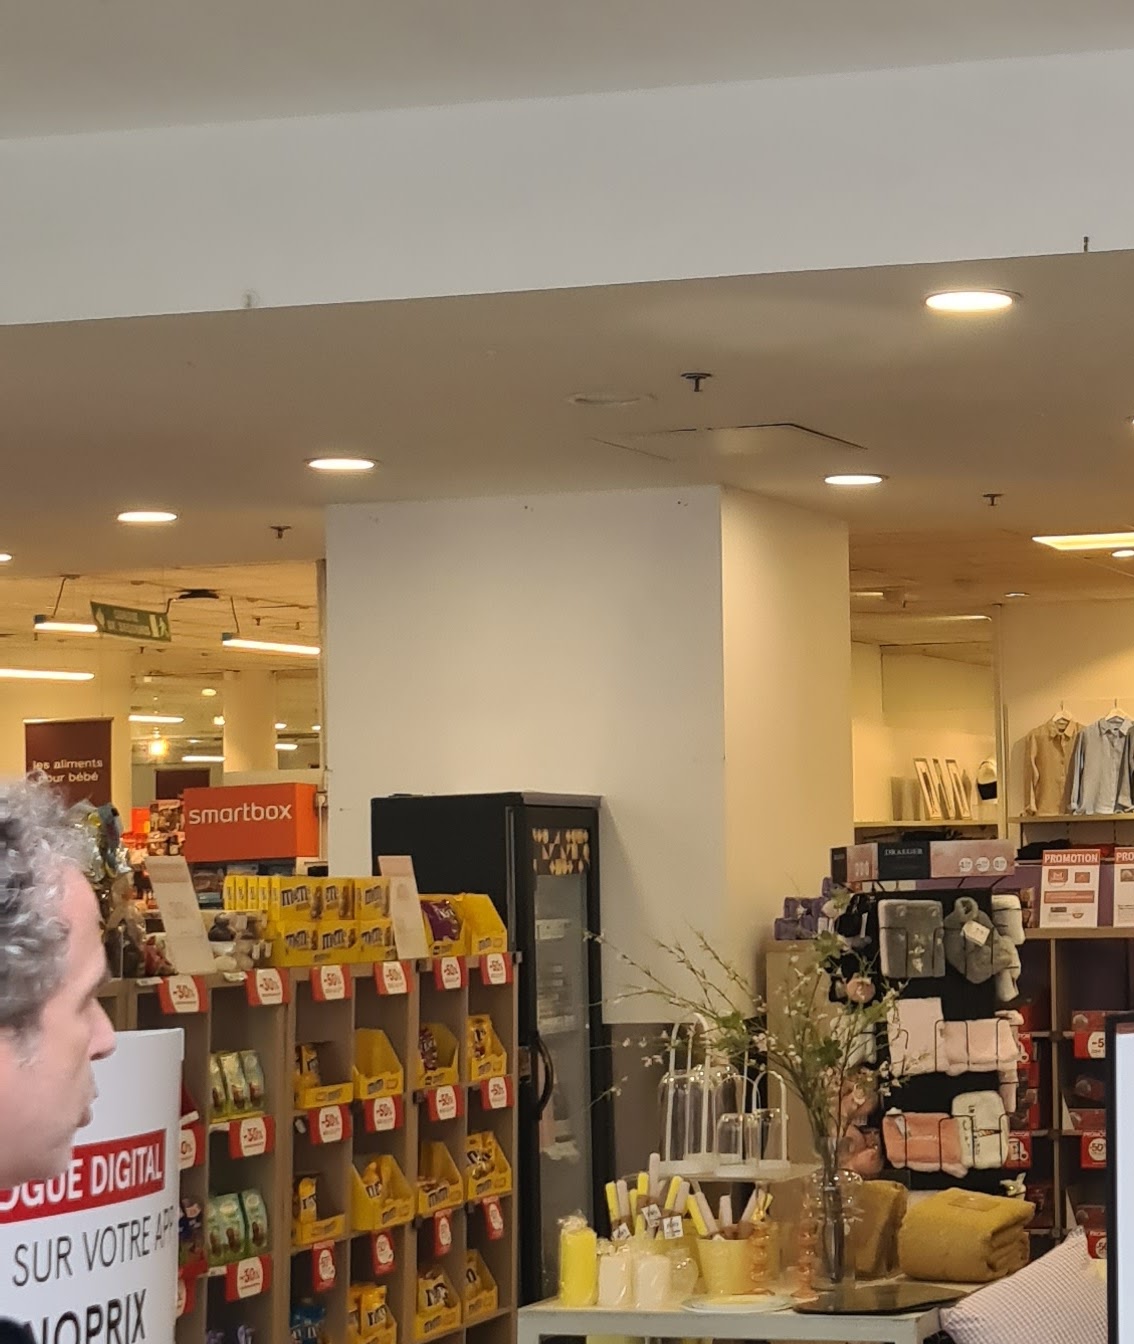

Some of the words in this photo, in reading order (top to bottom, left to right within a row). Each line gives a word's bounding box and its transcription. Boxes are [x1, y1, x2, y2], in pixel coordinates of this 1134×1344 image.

[32, 760, 51, 770] les
[54, 759, 103, 769] aliments
[68, 772, 99, 783] bébé
[188, 803, 292, 825] smartbox
[1044, 853, 1099, 864] PROMOTION
[90, 1143, 163, 1196] DIGITAL
[12, 1235, 73, 1287] SUR
[82, 1215, 152, 1272] VOTRE
